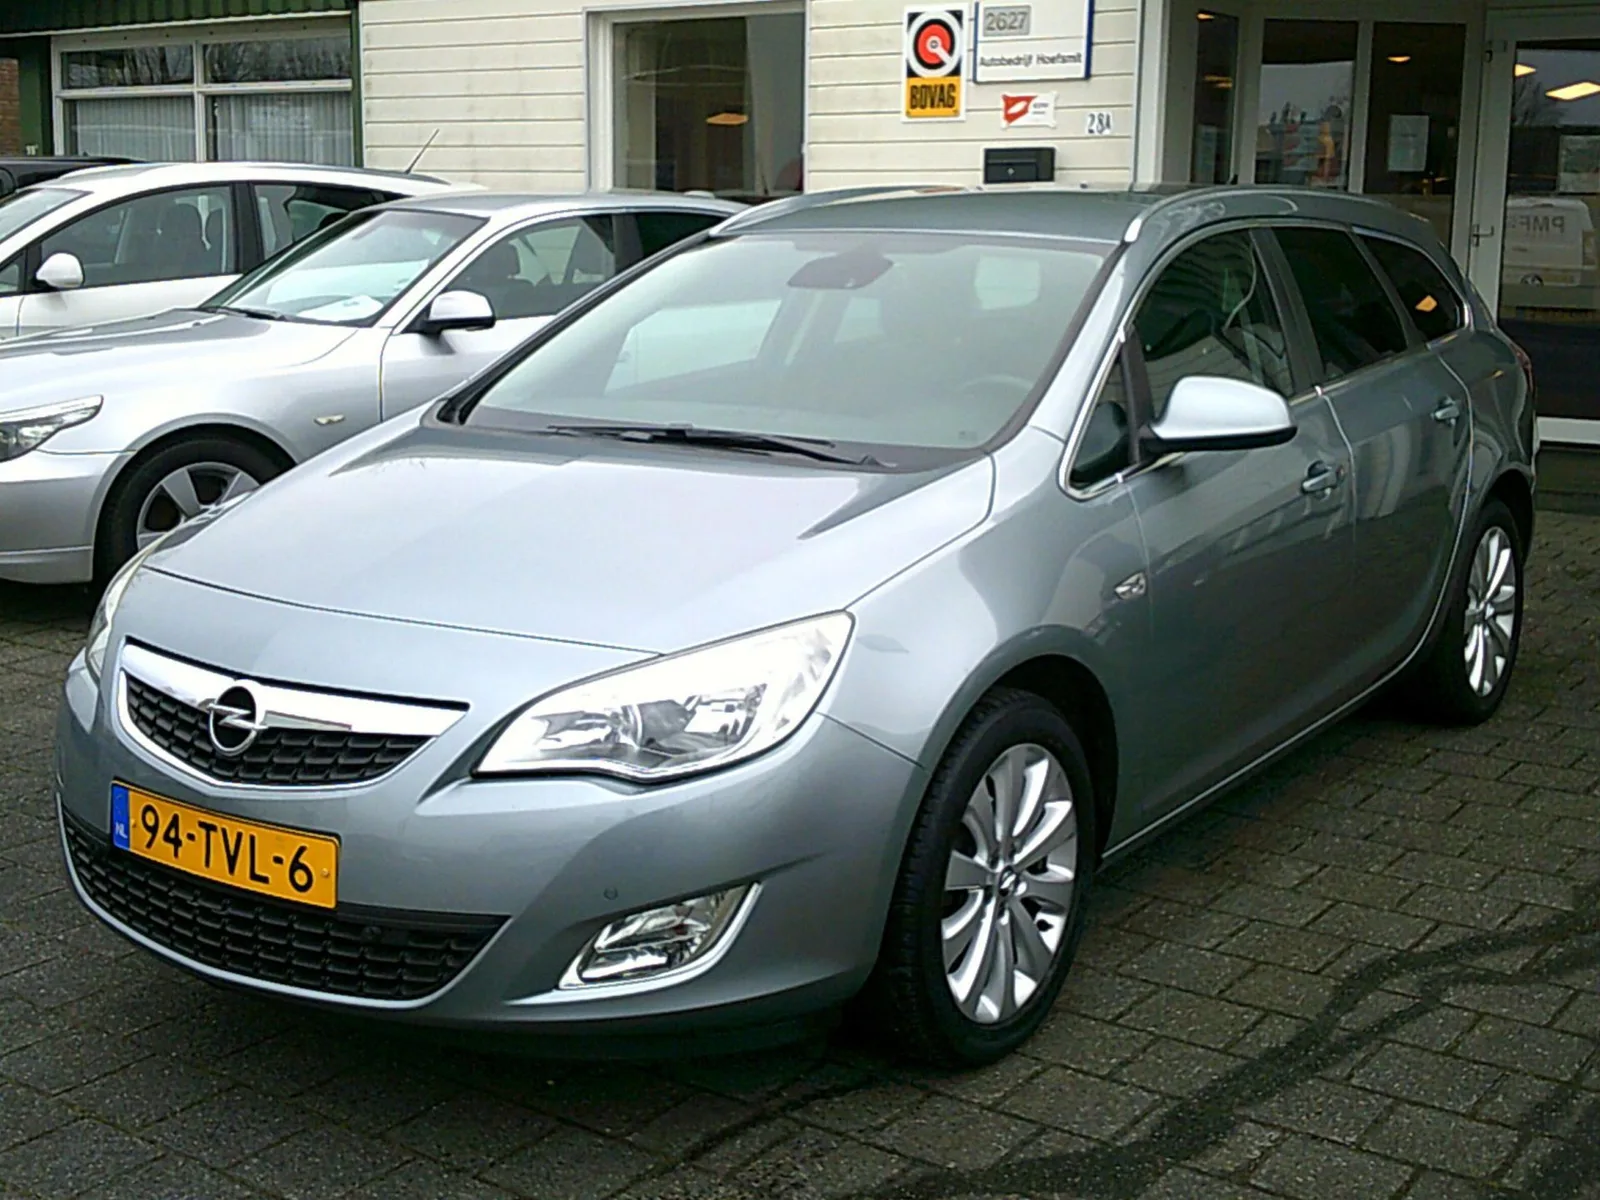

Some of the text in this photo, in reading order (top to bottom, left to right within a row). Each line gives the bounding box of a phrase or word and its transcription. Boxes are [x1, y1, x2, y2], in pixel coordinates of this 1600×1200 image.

[985, 11, 1029, 31] 2627
[979, 55, 1032, 68] Autobedrijf
[909, 83, 957, 110] BOVAG
[115, 822, 128, 839] NL
[141, 804, 314, 893] 94-TVL-6
